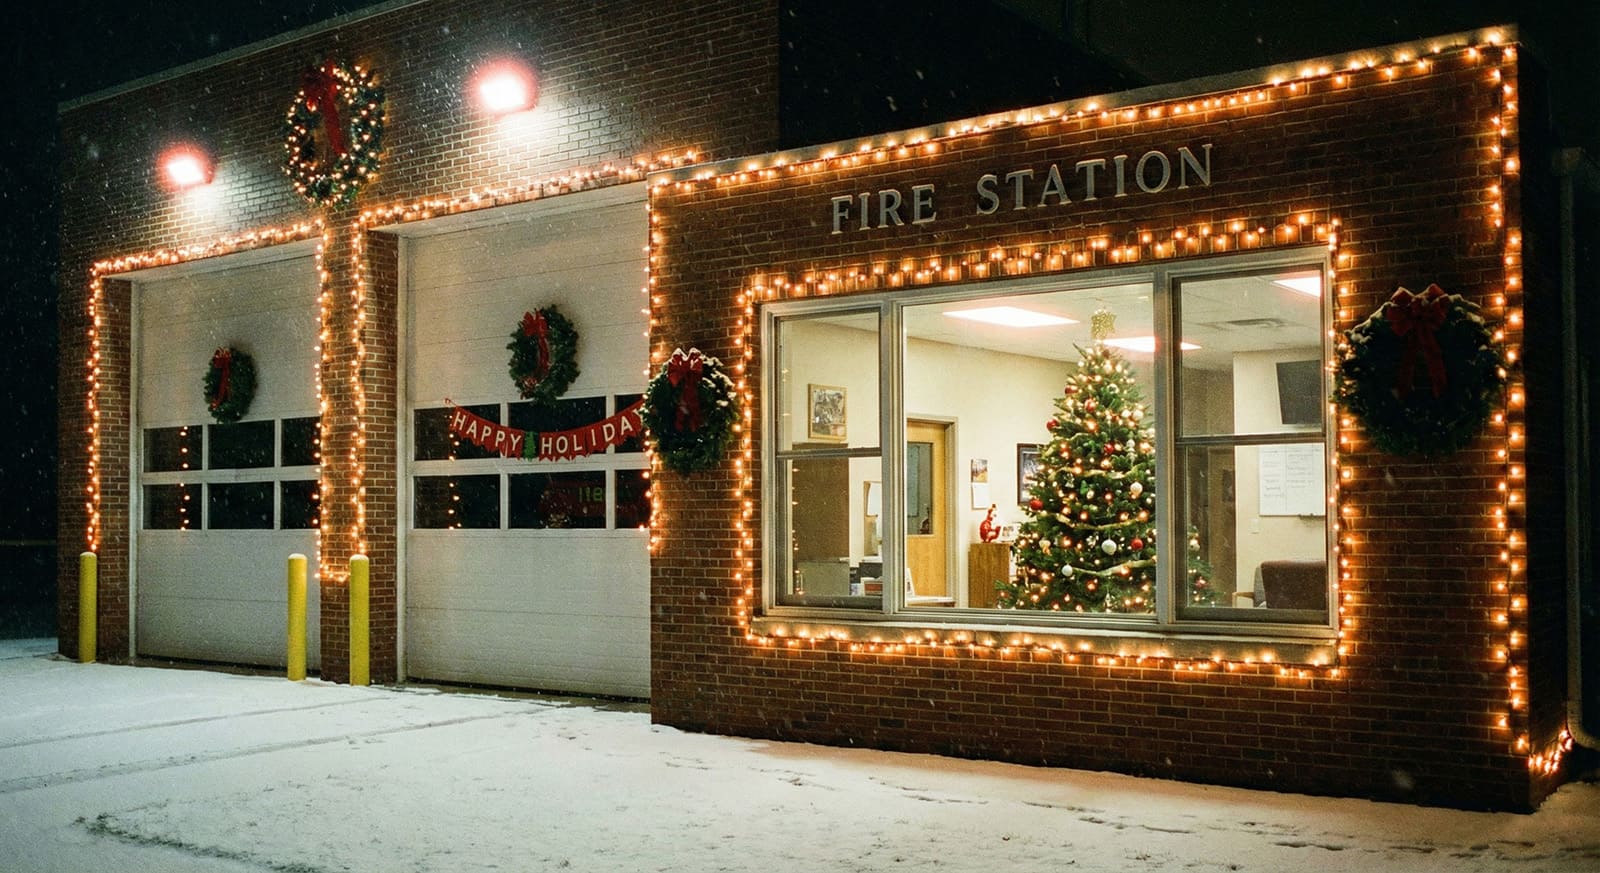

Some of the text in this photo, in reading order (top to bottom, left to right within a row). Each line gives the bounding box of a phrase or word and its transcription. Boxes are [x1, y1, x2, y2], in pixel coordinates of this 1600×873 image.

[830, 143, 1213, 235] FIRE STATION
[453, 411, 522, 452] HAPPY
